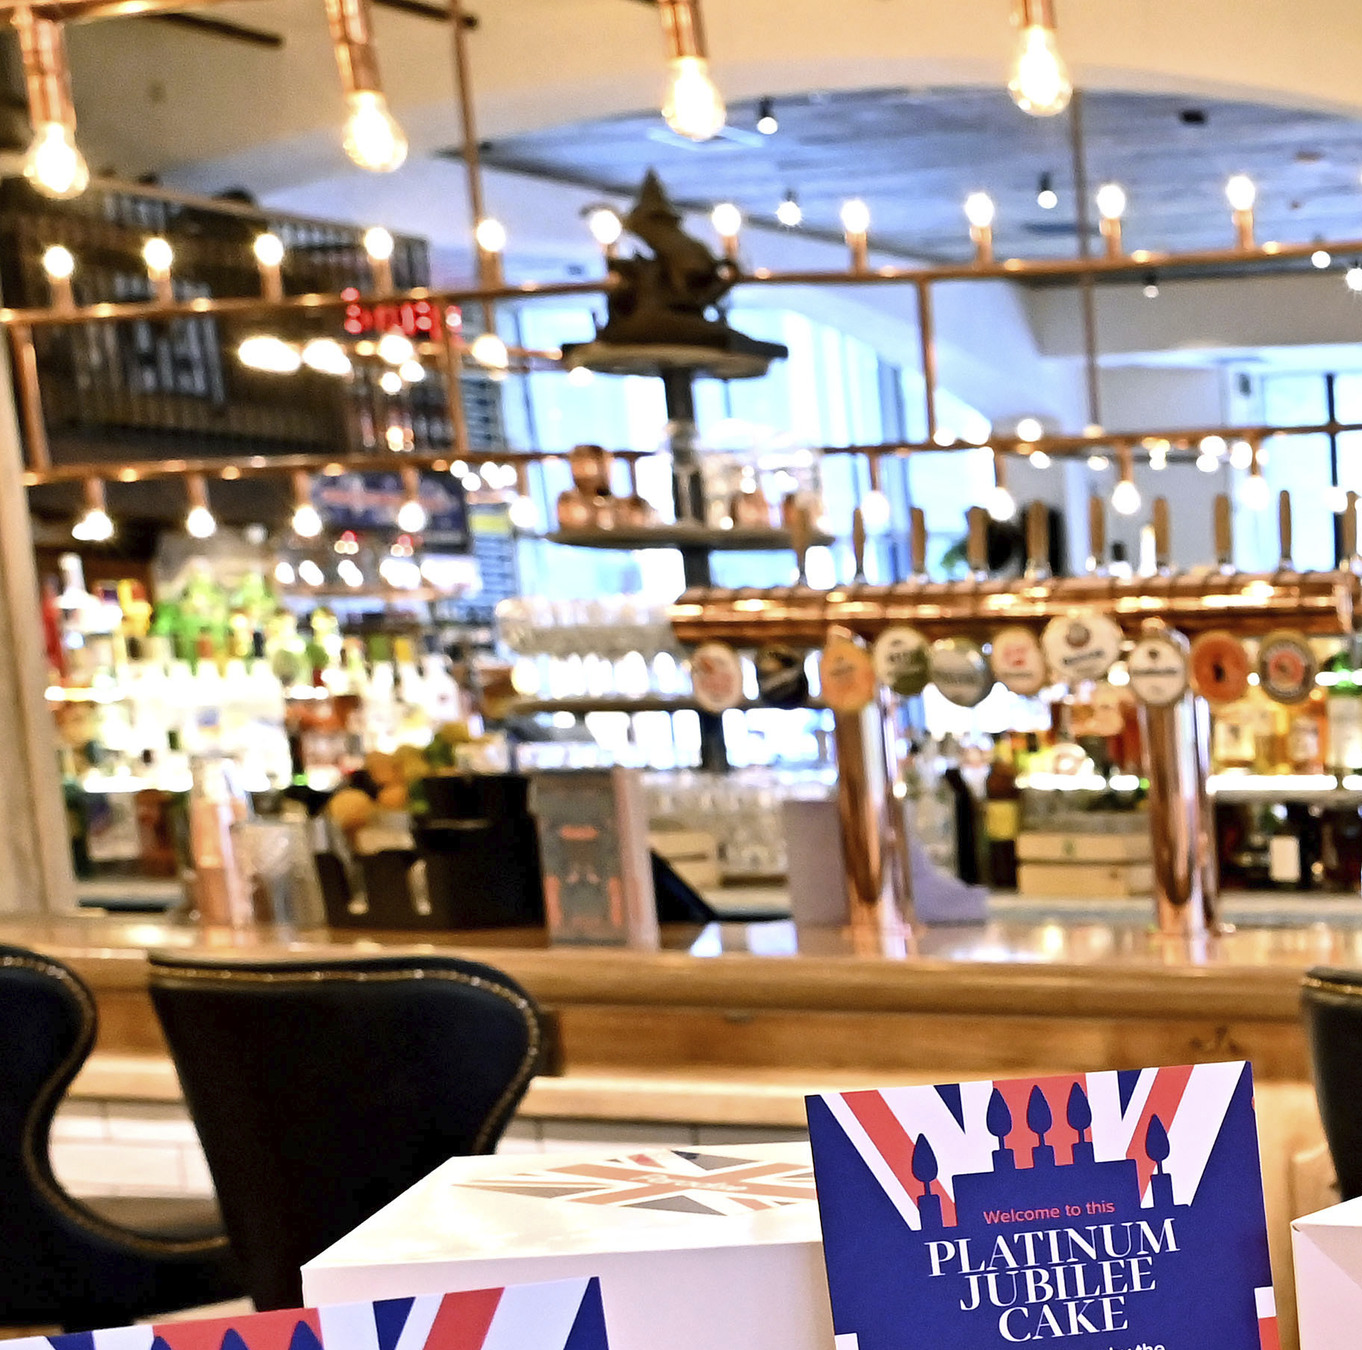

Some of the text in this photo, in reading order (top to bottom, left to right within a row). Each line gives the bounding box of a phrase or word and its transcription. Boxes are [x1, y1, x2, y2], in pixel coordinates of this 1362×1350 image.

[982, 1200, 1116, 1225] Welcome to this
[924, 1217, 1181, 1277] PLATINUM
[959, 1255, 1156, 1311] JUBILEE
[998, 1295, 1128, 1342] CAKE
